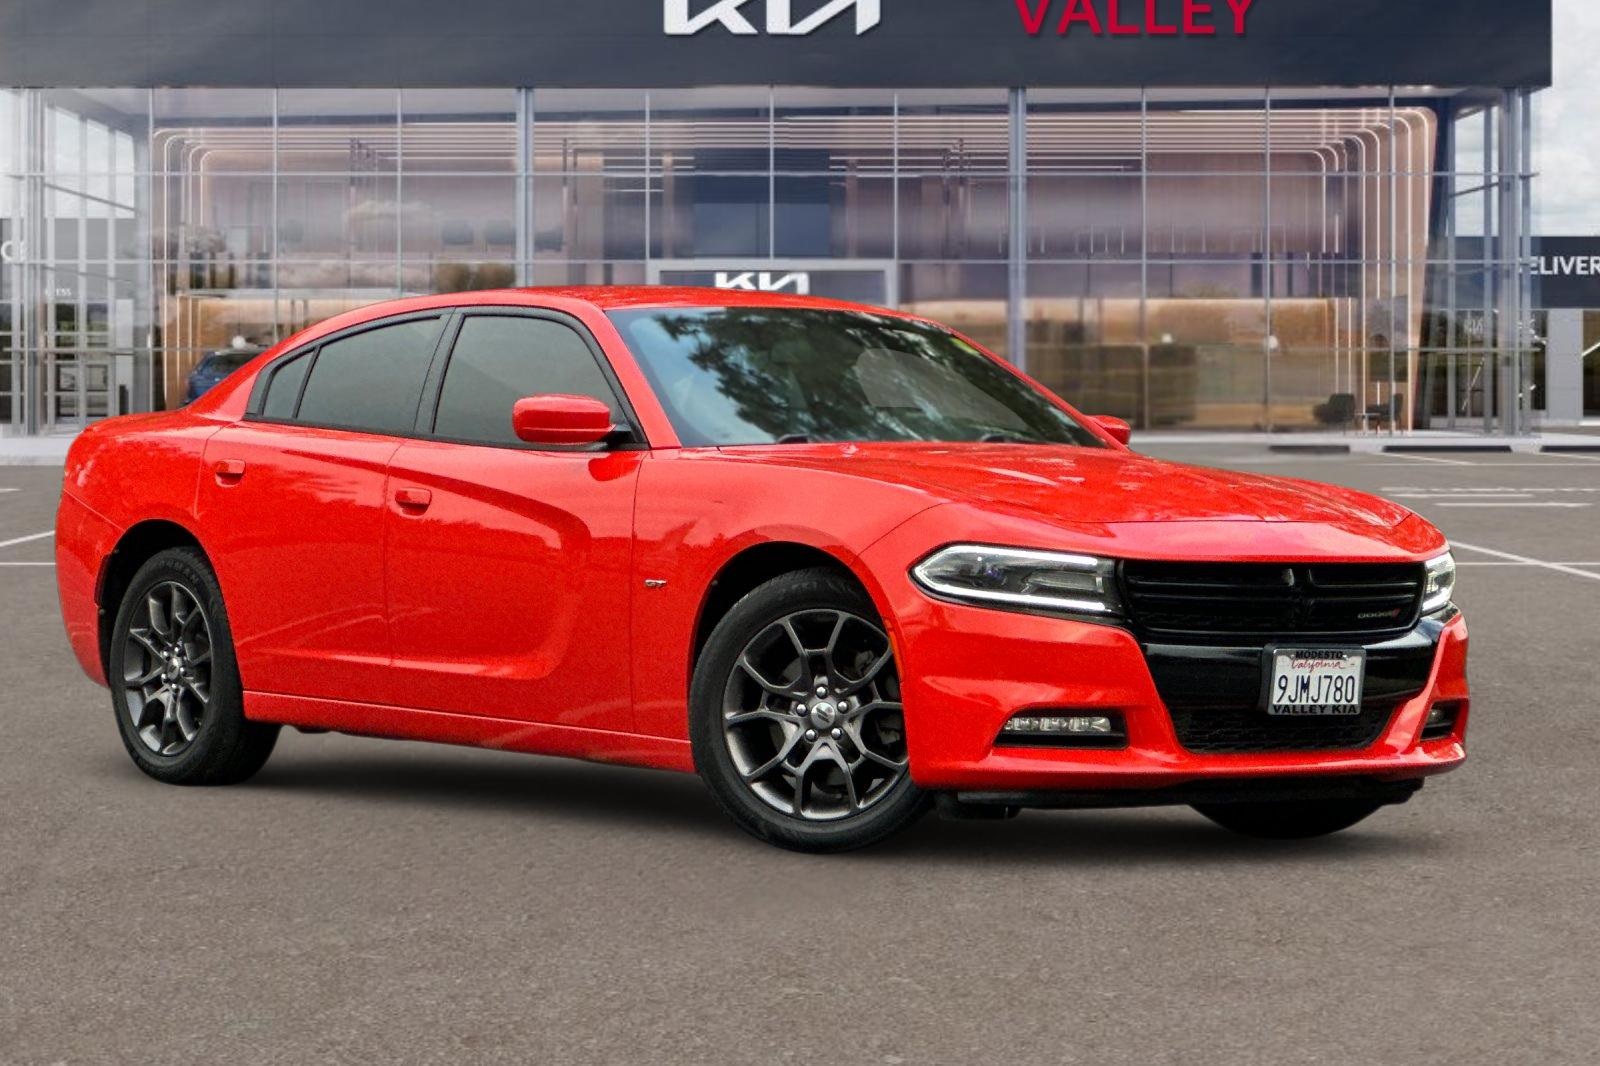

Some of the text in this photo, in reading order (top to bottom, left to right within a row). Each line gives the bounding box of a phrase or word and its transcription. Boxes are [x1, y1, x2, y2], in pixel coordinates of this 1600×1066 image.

[1014, 0, 1253, 34] VALLEY
[715, 271, 810, 295] KIA
[1295, 650, 1344, 660] MODESTO
[1291, 658, 1346, 673] California
[1276, 674, 1356, 704] 9JMJ780
[1273, 704, 1358, 715] VALLEY KIA
